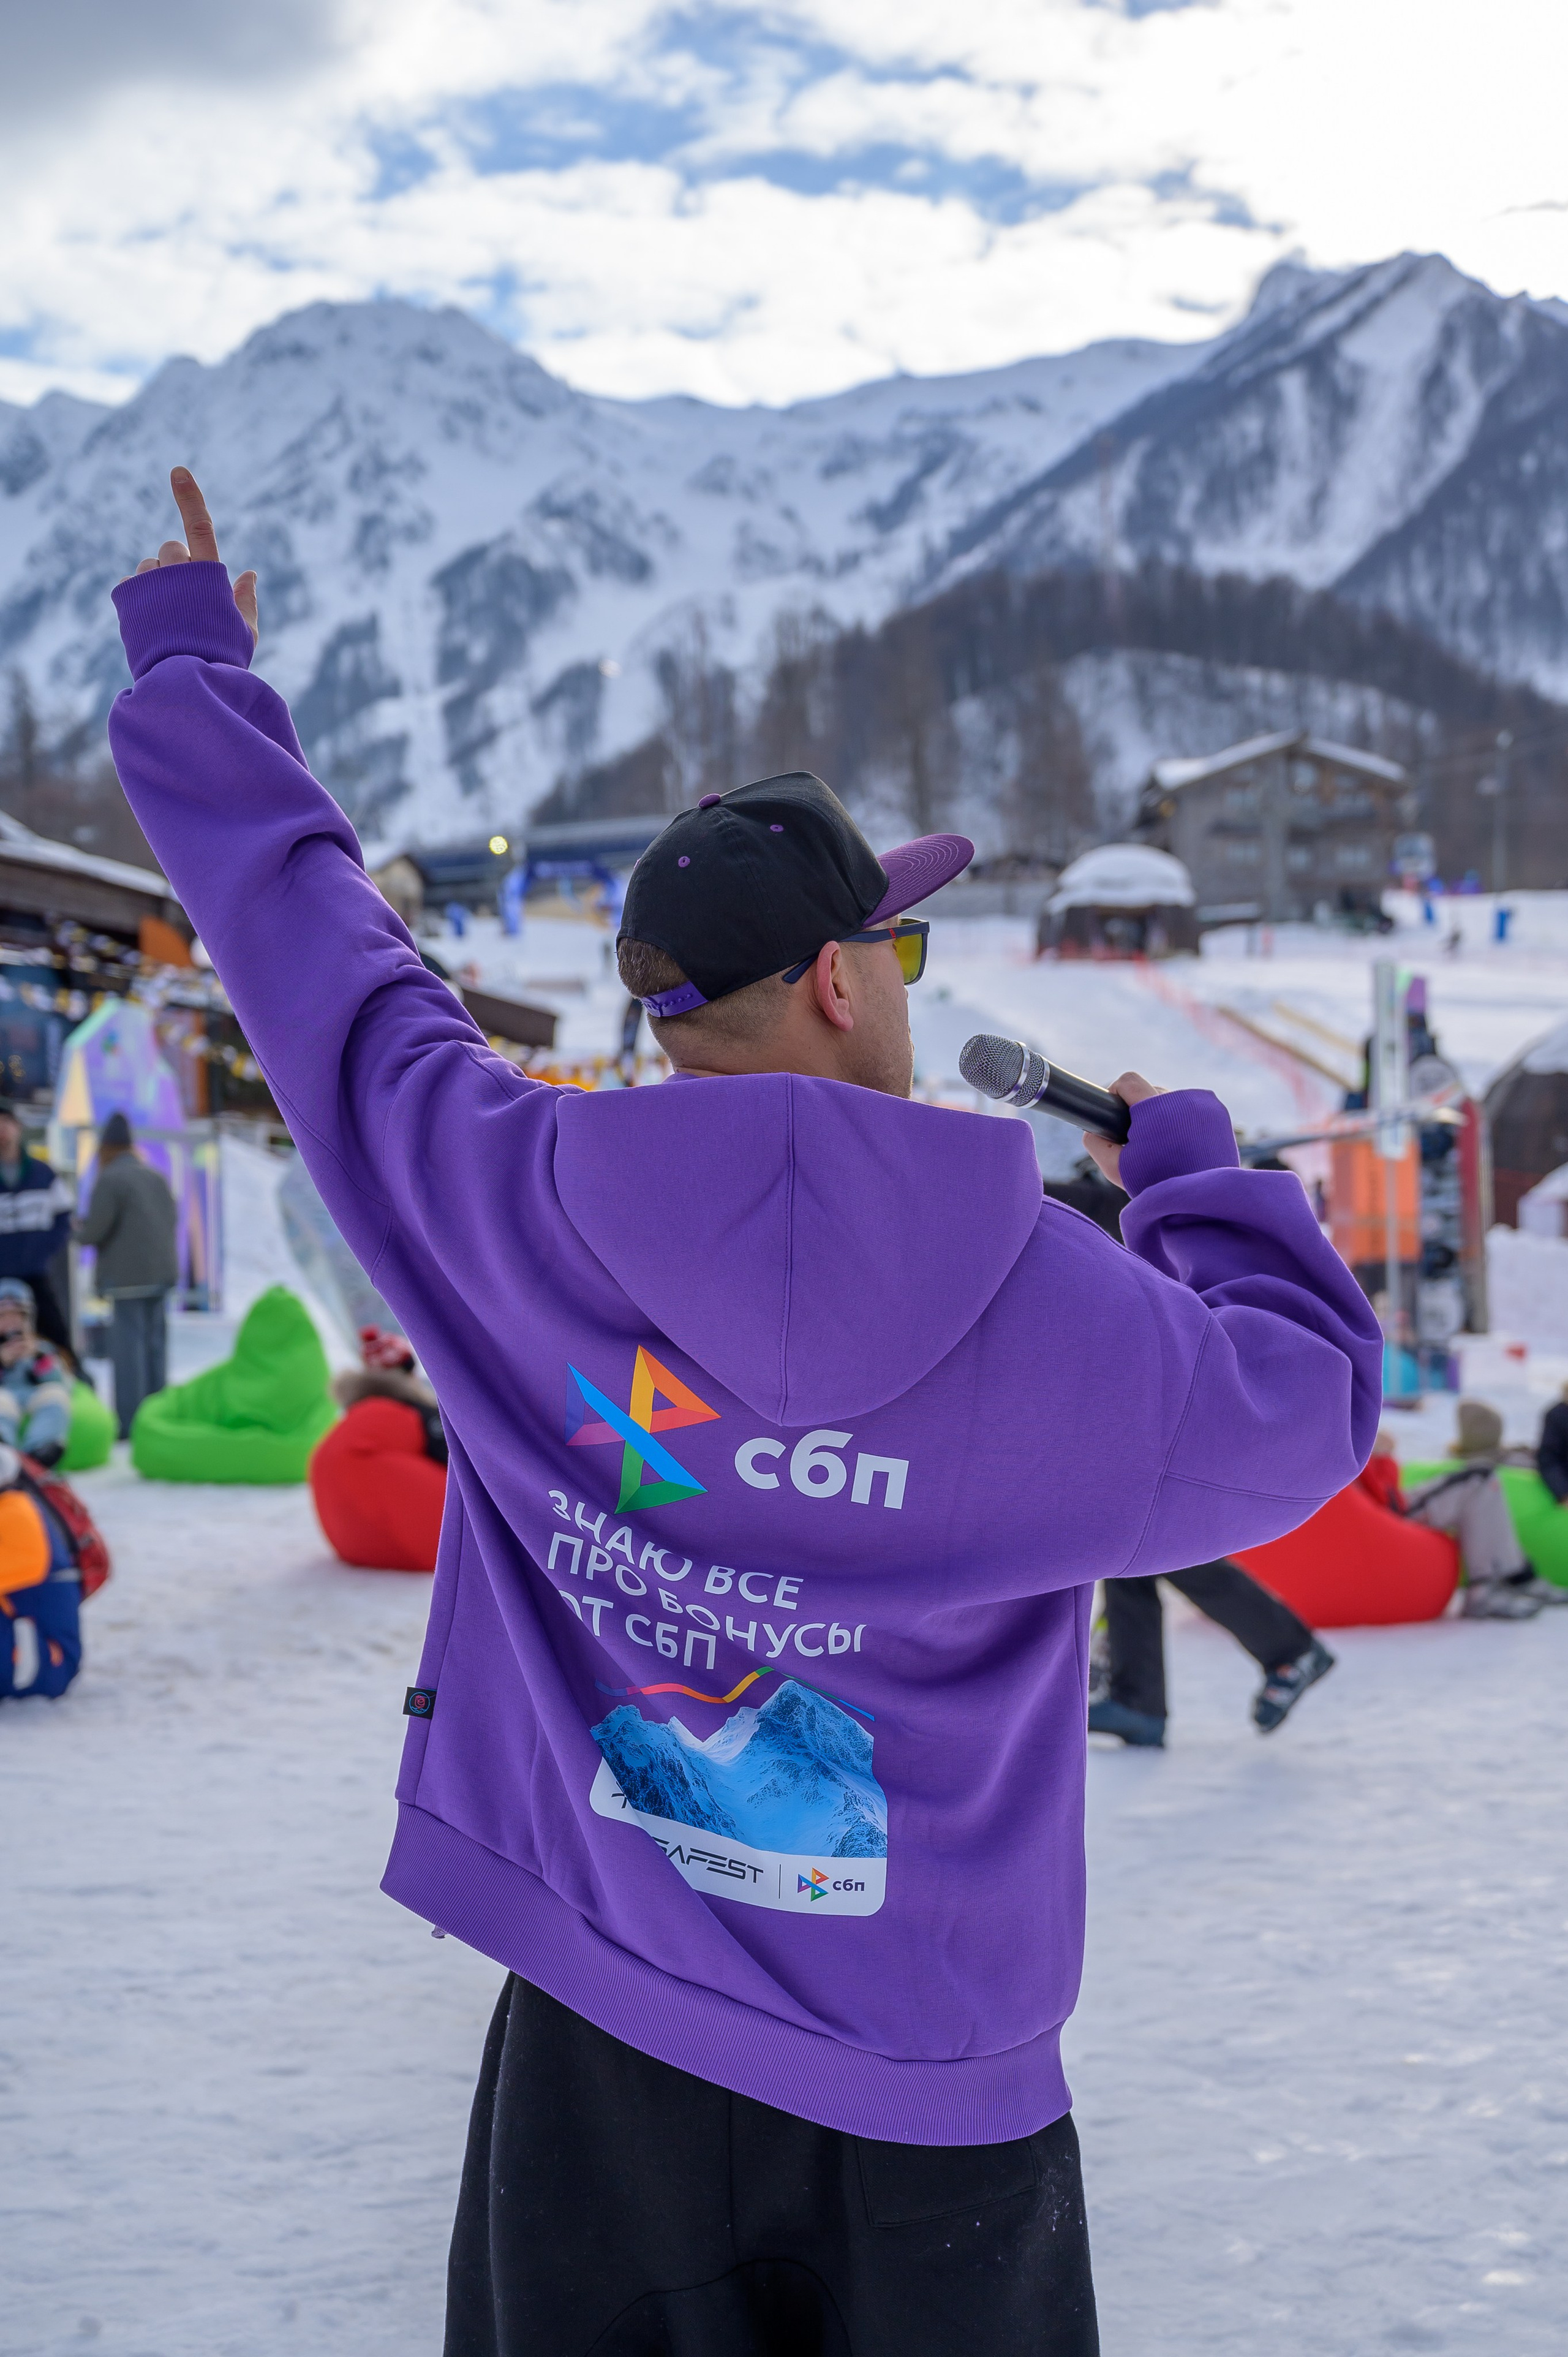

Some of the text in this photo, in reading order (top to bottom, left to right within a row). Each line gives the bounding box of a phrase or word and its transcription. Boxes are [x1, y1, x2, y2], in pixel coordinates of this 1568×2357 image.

[734, 1429, 910, 1510] сбп
[548, 1489, 804, 1610] ЗНАЮ ВСЕ
[547, 1531, 867, 1659] ПРО БОНУСЫ
[625, 1613, 717, 1670] СБП
[832, 1878, 865, 1892] сбп
